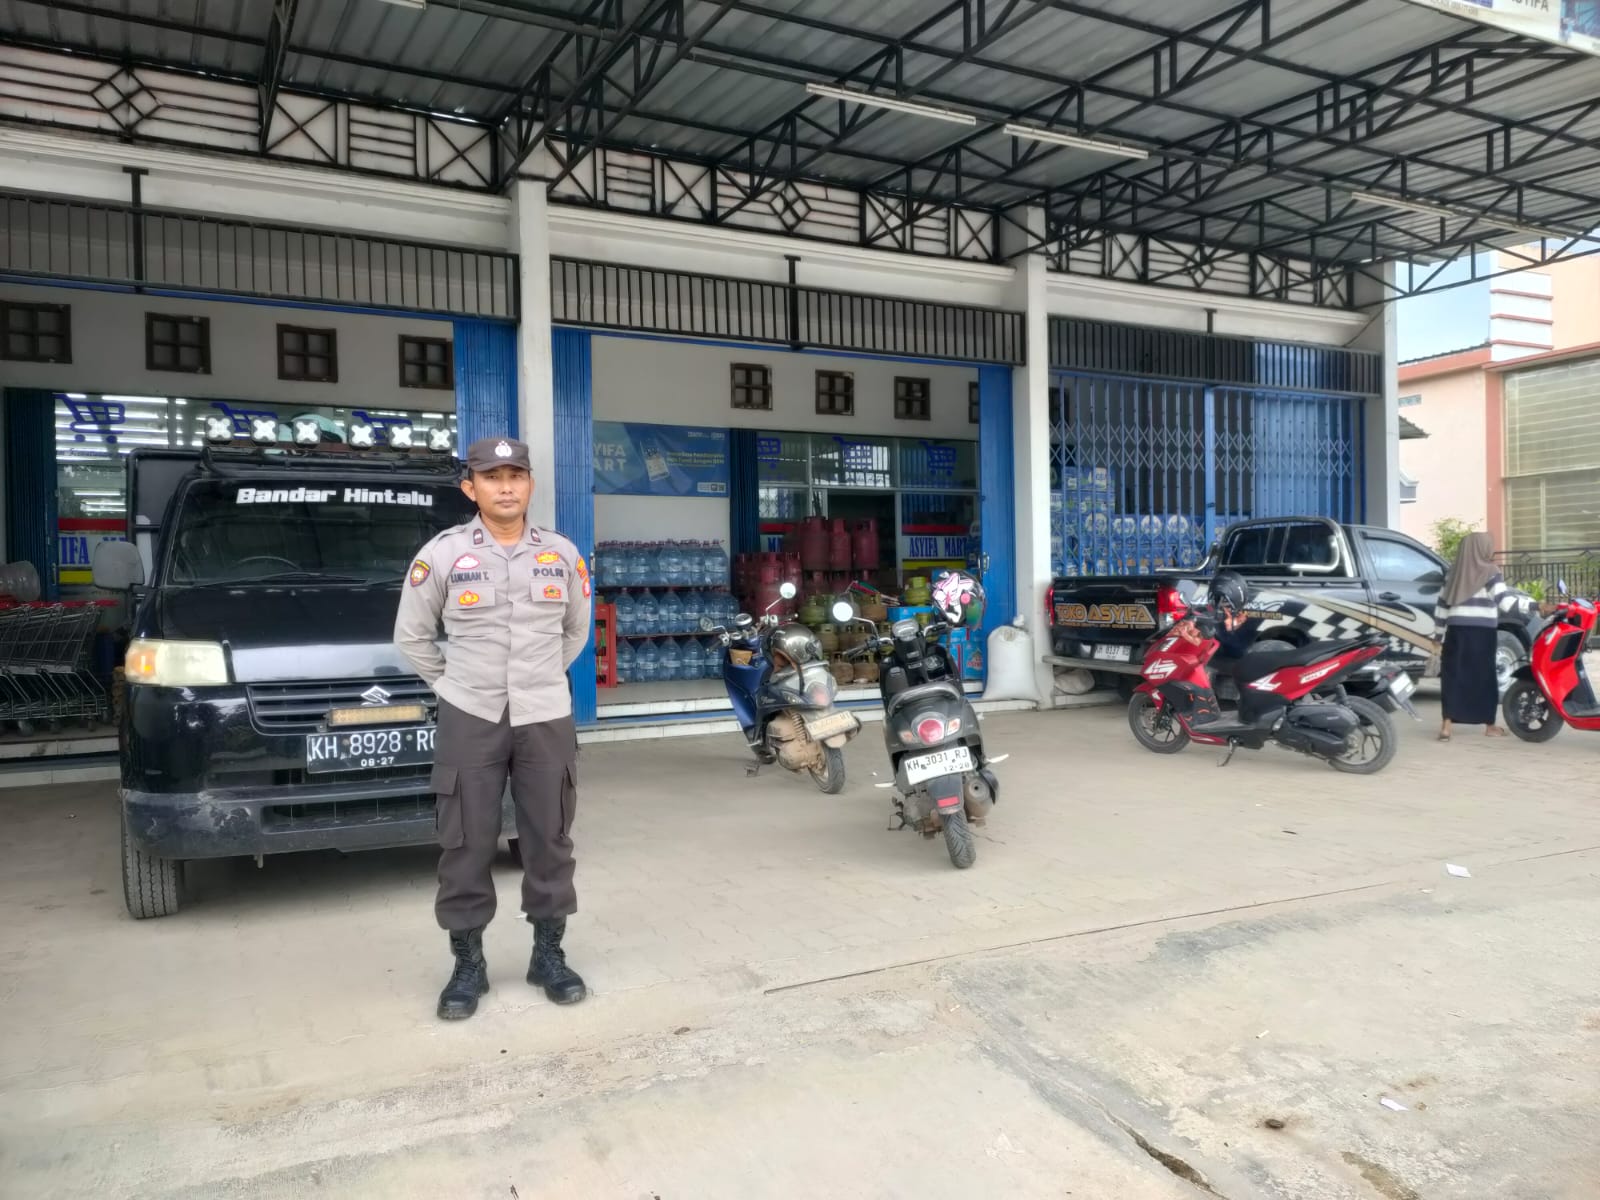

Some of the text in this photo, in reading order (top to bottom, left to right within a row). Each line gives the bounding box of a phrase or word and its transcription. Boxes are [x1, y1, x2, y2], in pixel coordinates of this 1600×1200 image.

[236, 487, 433, 506] Bandar Hintalu
[910, 536, 938, 557] ASYIFA
[532, 567, 564, 577] POLRI
[1056, 603, 1153, 622] TOKO ASYIFA
[311, 736, 338, 759] KH
[350, 731, 401, 755] 8928
[907, 748, 968, 771] KH 3031 RJ
